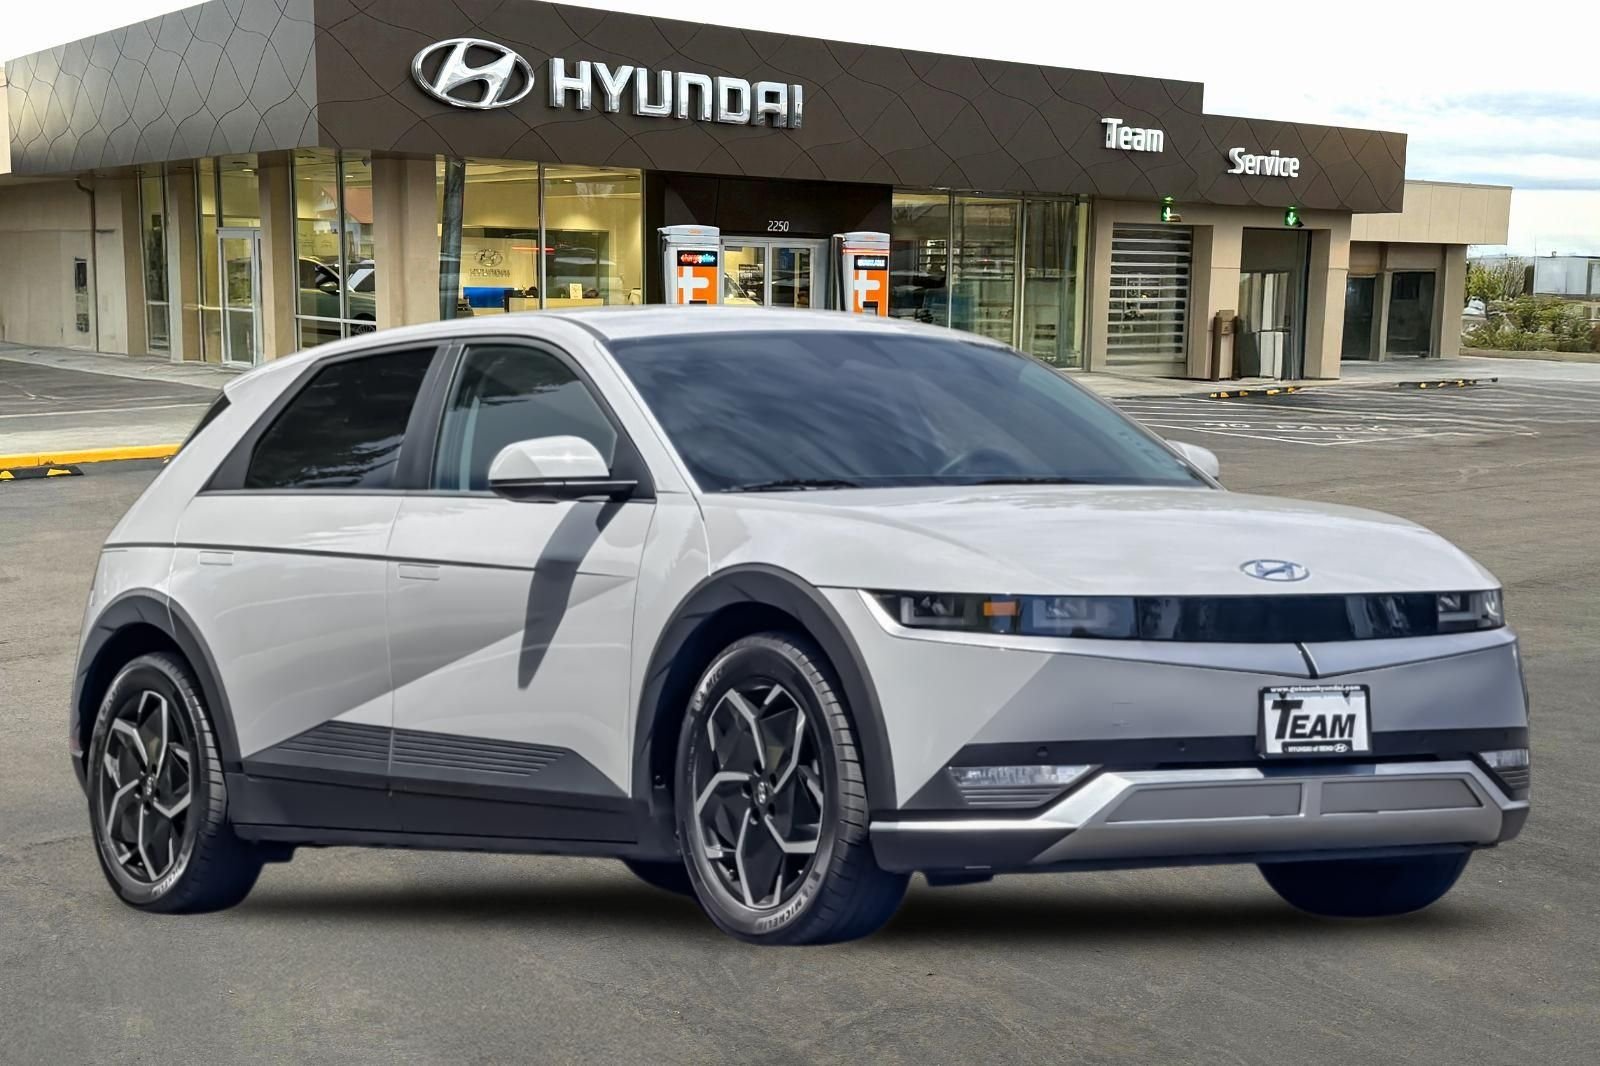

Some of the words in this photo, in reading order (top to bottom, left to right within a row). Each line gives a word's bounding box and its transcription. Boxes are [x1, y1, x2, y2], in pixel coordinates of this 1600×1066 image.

[549, 57, 803, 129] HYUNDAI
[1101, 117, 1164, 153] Team
[1227, 147, 1300, 178] Service
[767, 220, 790, 232] 2250
